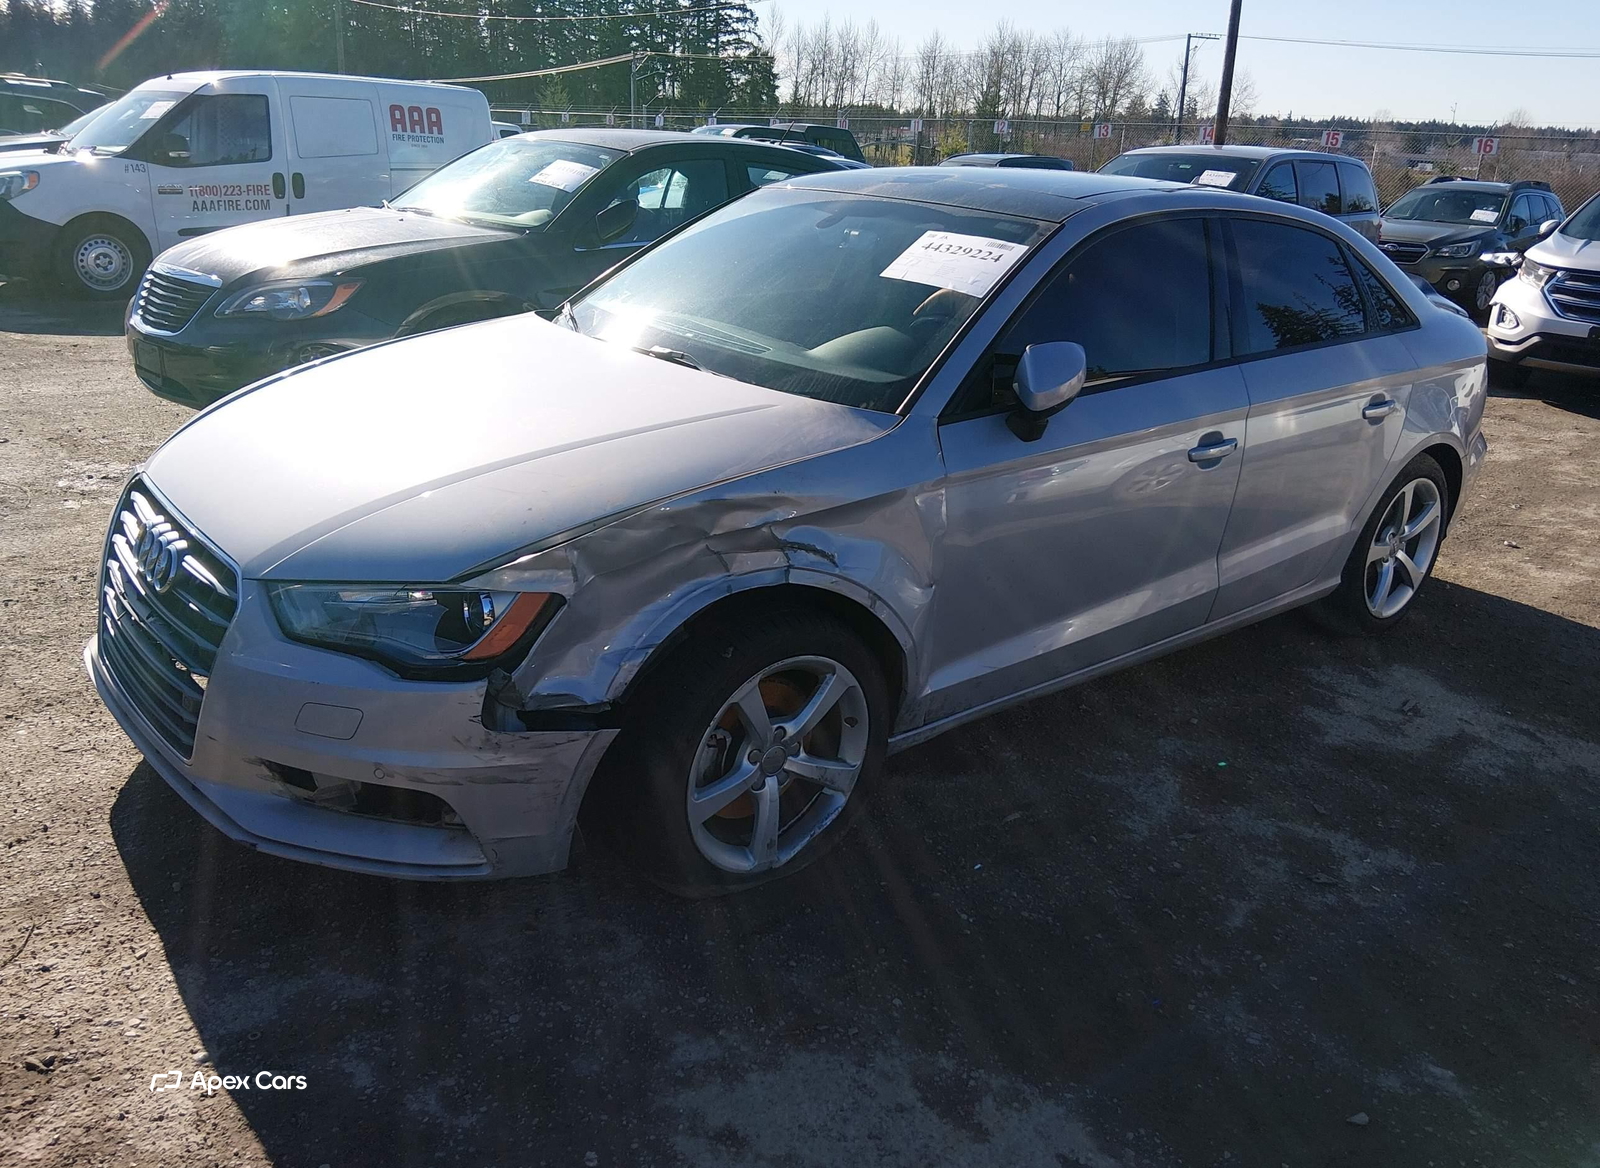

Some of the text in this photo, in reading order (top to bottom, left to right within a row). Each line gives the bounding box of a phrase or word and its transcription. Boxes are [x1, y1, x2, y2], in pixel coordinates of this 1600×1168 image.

[389, 104, 443, 135] AAA
[839, 119, 847, 128] 10
[996, 120, 1005, 133] 12
[1097, 124, 1109, 137] 13
[392, 134, 444, 144] FIRE PROTECTION
[1202, 128, 1213, 140] 14
[1325, 132, 1340, 146] 15
[1477, 139, 1493, 153] 16
[124, 164, 146, 173] #143
[188, 184, 271, 198] 1(800)223-FIRE
[192, 199, 271, 212] AAAFIRE.COM
[921, 242, 1004, 263] 44329224
